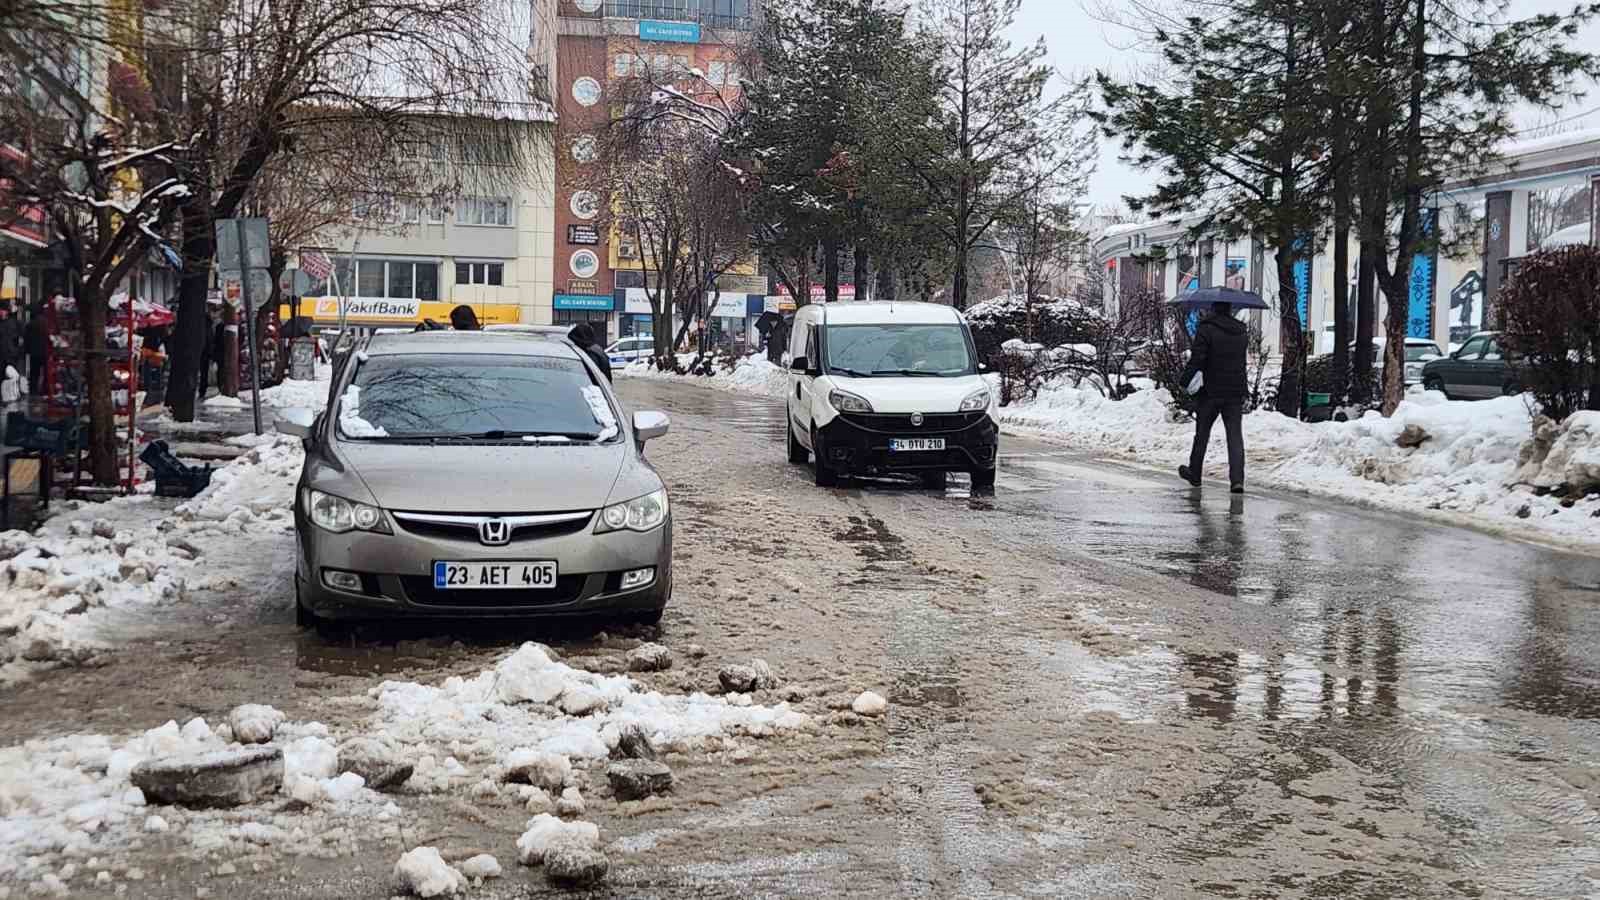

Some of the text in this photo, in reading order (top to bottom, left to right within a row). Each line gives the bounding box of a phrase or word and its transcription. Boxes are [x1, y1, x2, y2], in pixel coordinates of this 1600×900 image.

[895, 441, 905, 449] 34
[928, 440, 942, 449] 210
[448, 566, 552, 585] 23 AET 405
